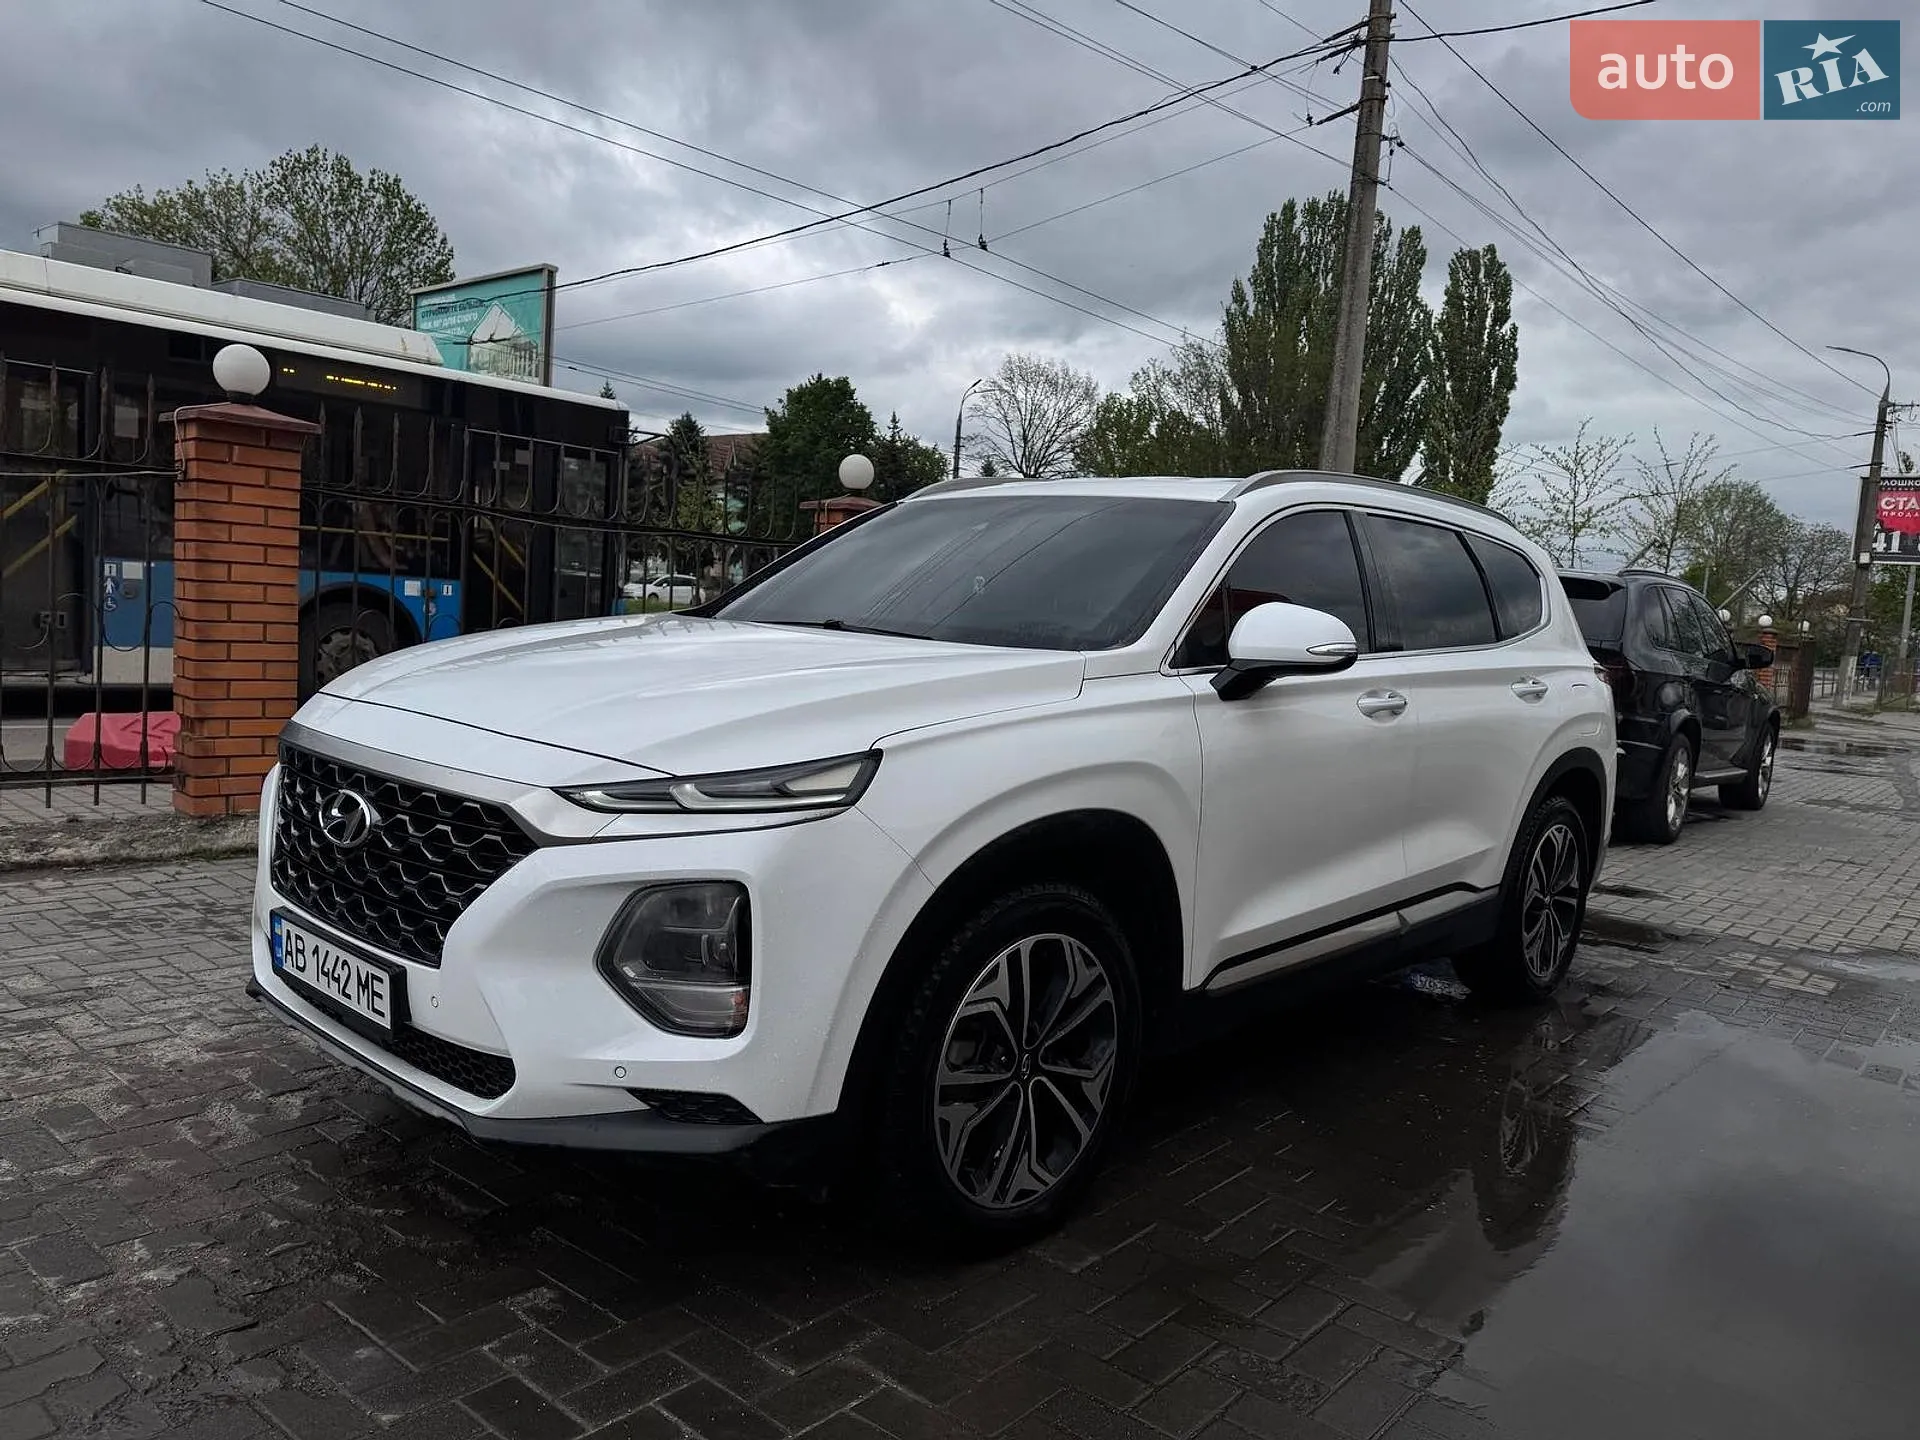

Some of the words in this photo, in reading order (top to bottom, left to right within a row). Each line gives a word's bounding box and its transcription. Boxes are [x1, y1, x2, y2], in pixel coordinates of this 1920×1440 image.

[1881, 479, 1920, 487] ЛОШКО
[1881, 497, 1920, 510] СТА
[284, 929, 306, 973] AB
[312, 944, 352, 1001] 1442
[356, 965, 386, 1018] ME
